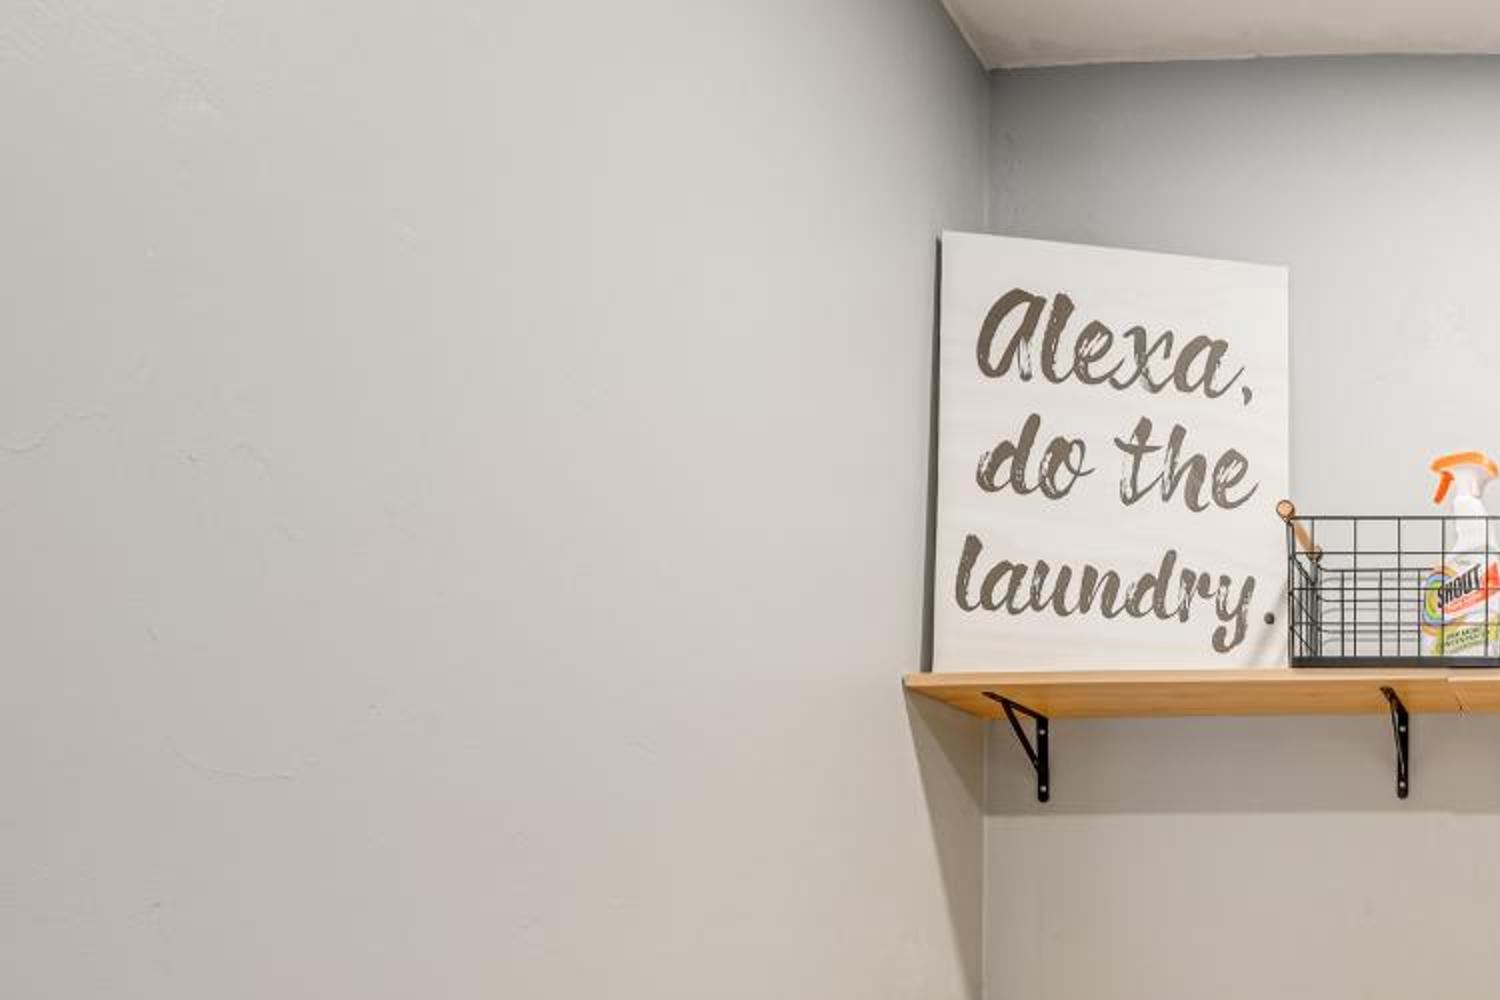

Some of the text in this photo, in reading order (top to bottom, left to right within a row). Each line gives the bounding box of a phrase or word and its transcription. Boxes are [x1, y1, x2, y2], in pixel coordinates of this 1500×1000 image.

[976, 413, 1259, 513] do the
[955, 534, 1275, 654] laundry.
